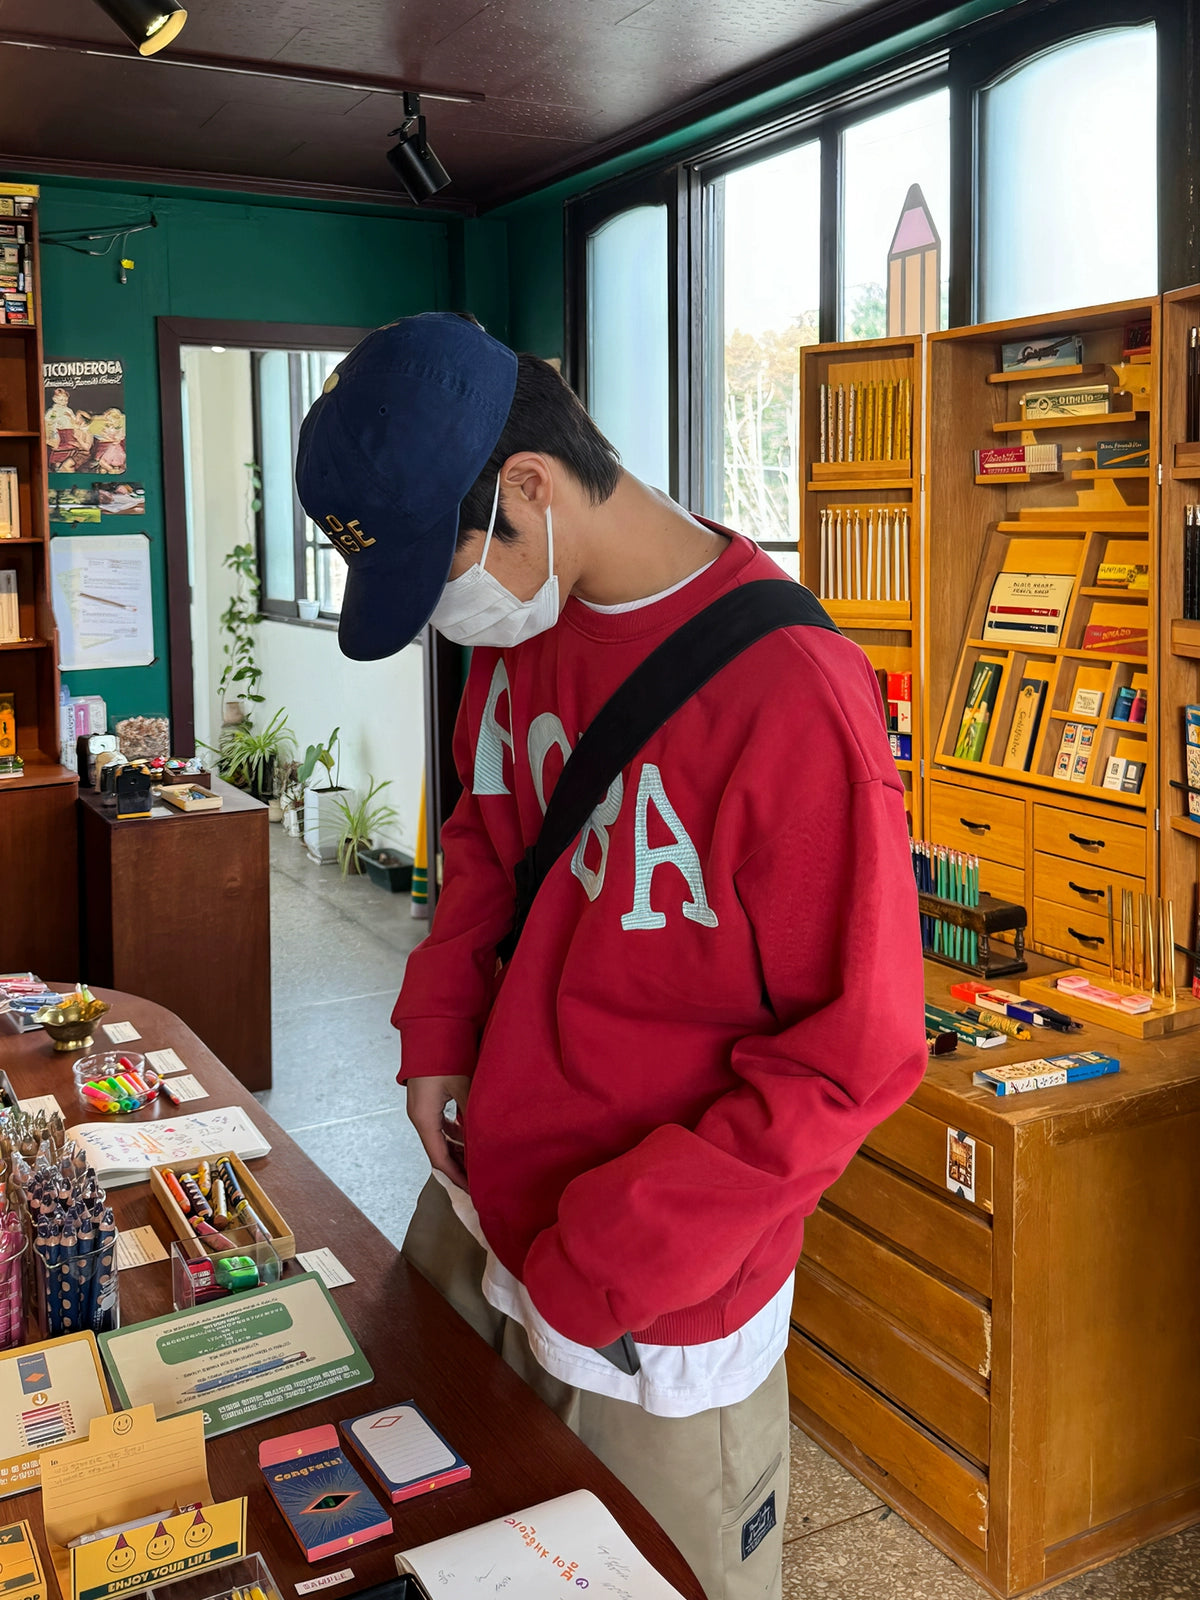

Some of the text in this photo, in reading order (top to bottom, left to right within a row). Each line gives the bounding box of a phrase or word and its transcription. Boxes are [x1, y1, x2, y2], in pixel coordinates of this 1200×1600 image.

[43, 361, 123, 377] TICONDEROGA
[108, 1551, 212, 1593] ENJOY YOUR LIFE
